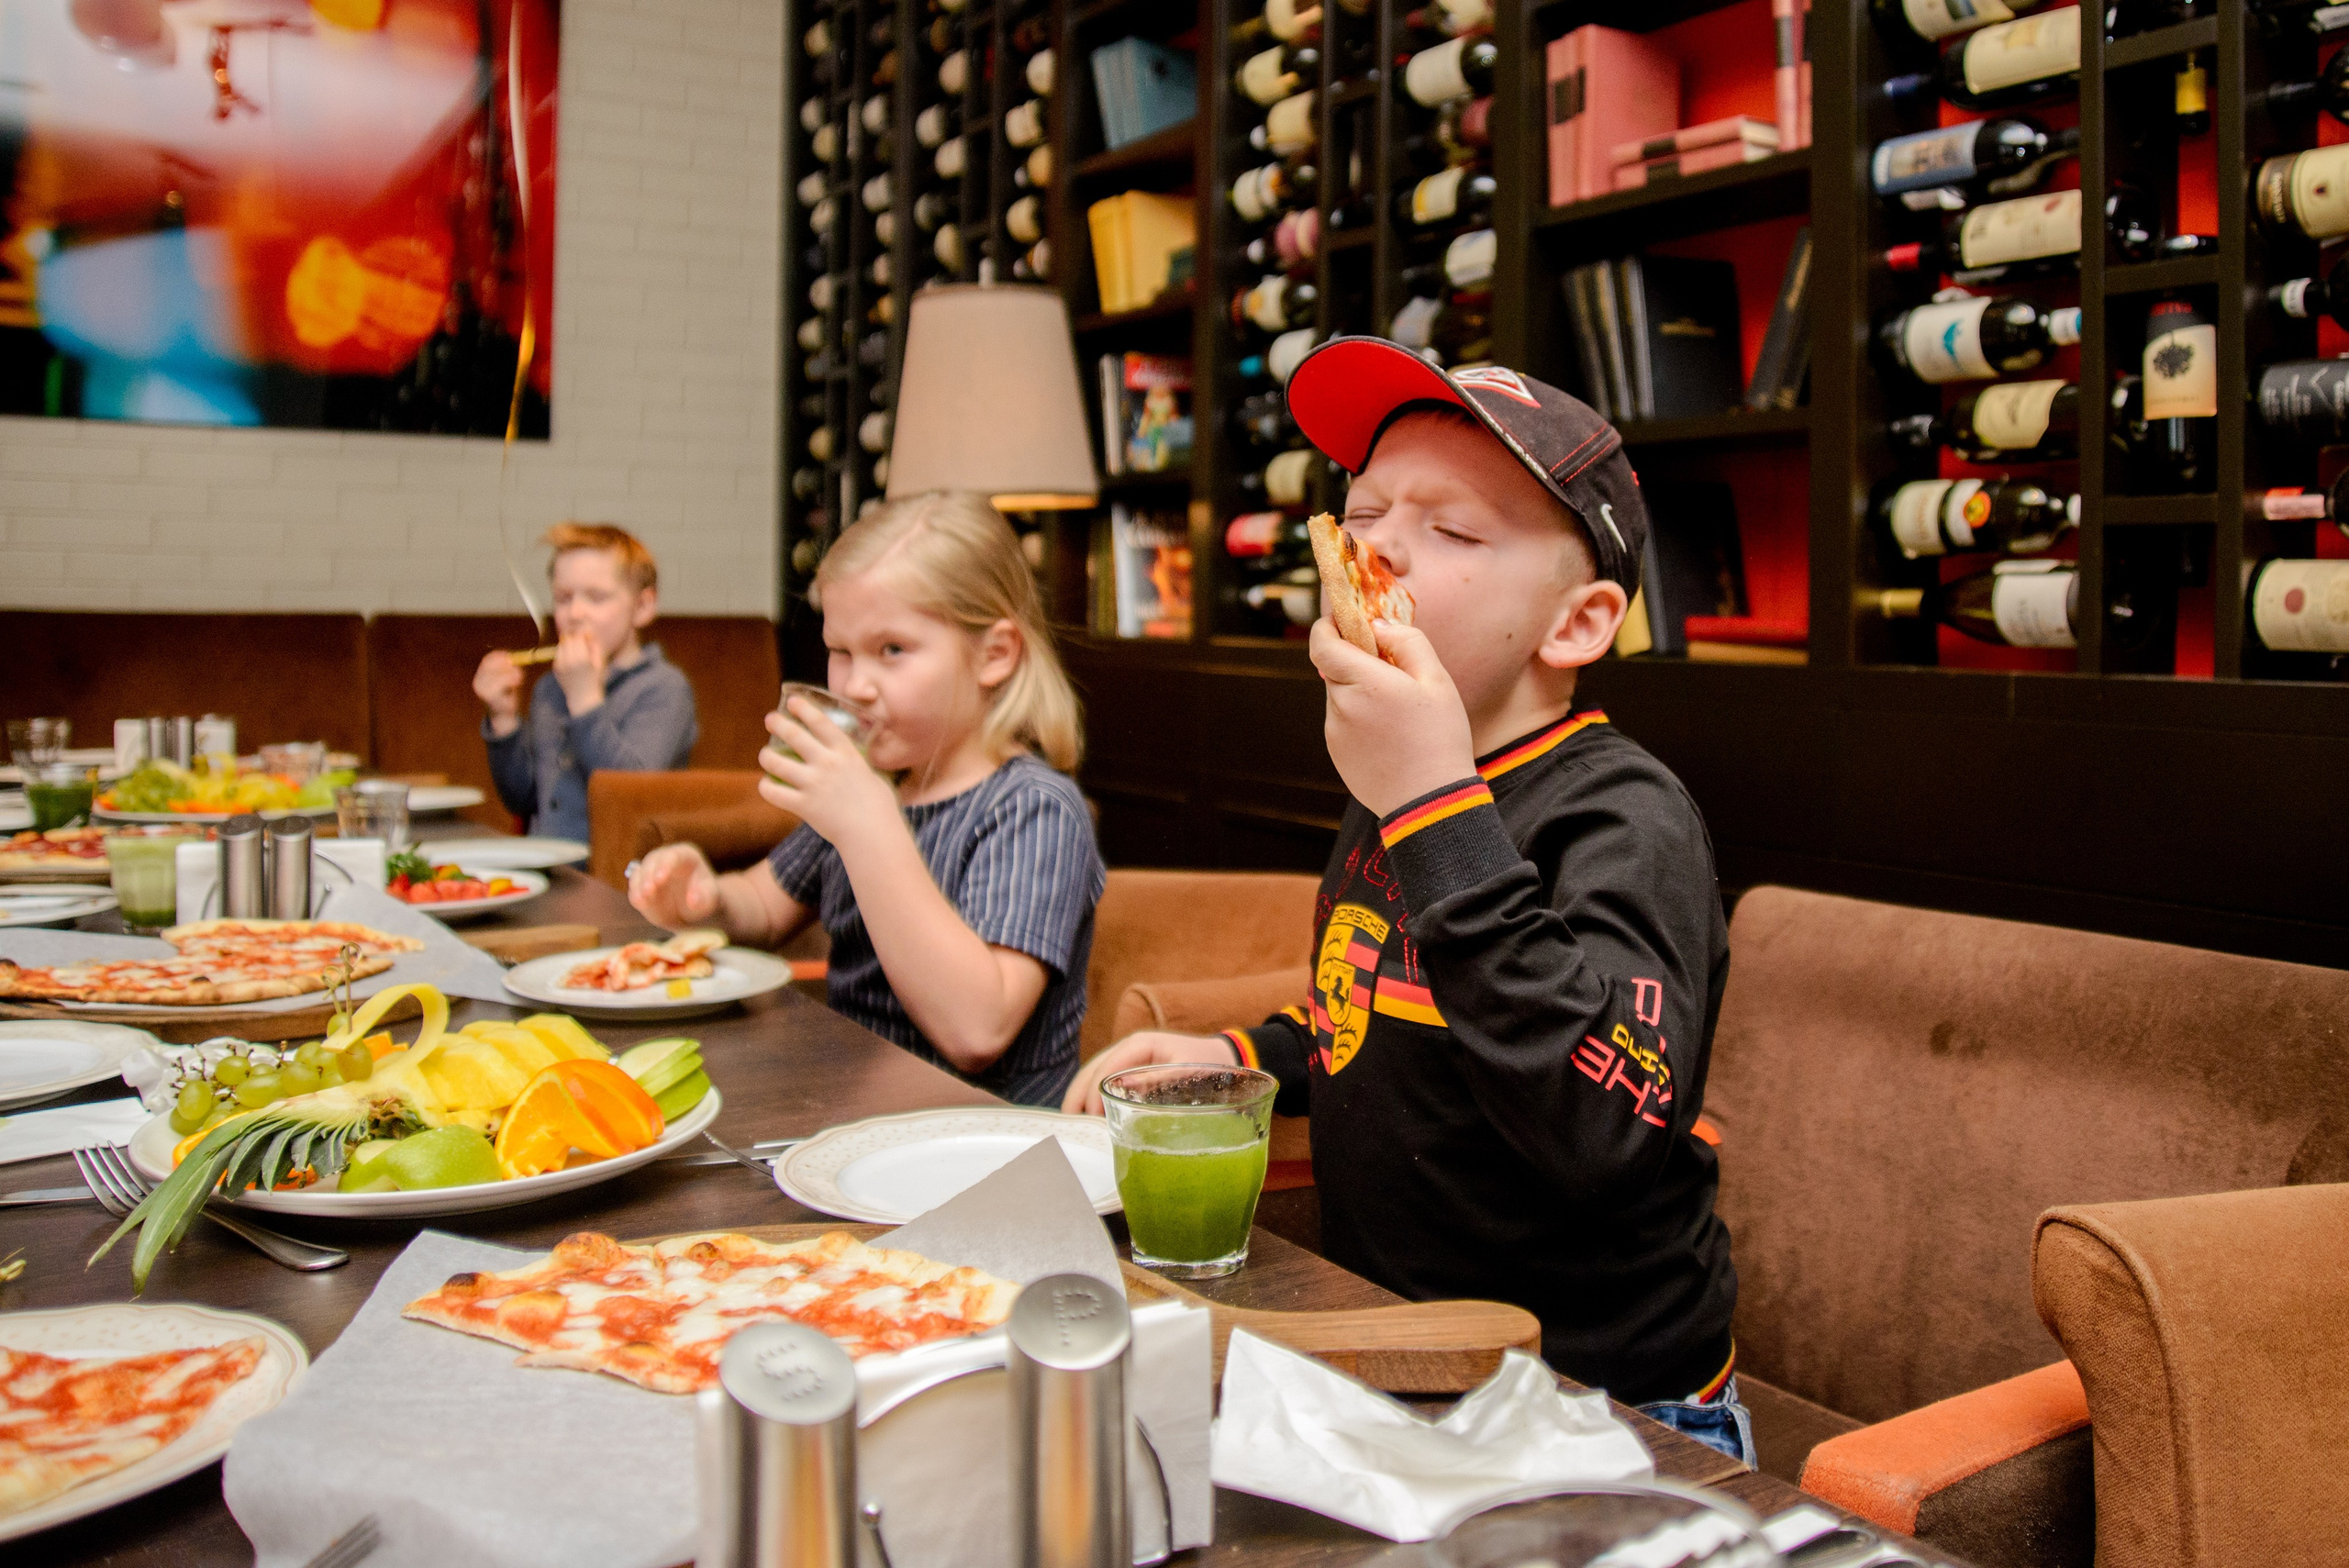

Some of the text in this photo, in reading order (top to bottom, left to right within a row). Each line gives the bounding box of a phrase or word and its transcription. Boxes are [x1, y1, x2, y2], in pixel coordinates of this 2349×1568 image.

[1333, 907, 1386, 940] PORSCHE
[1052, 1287, 1101, 1347] P
[755, 1340, 824, 1403] S
